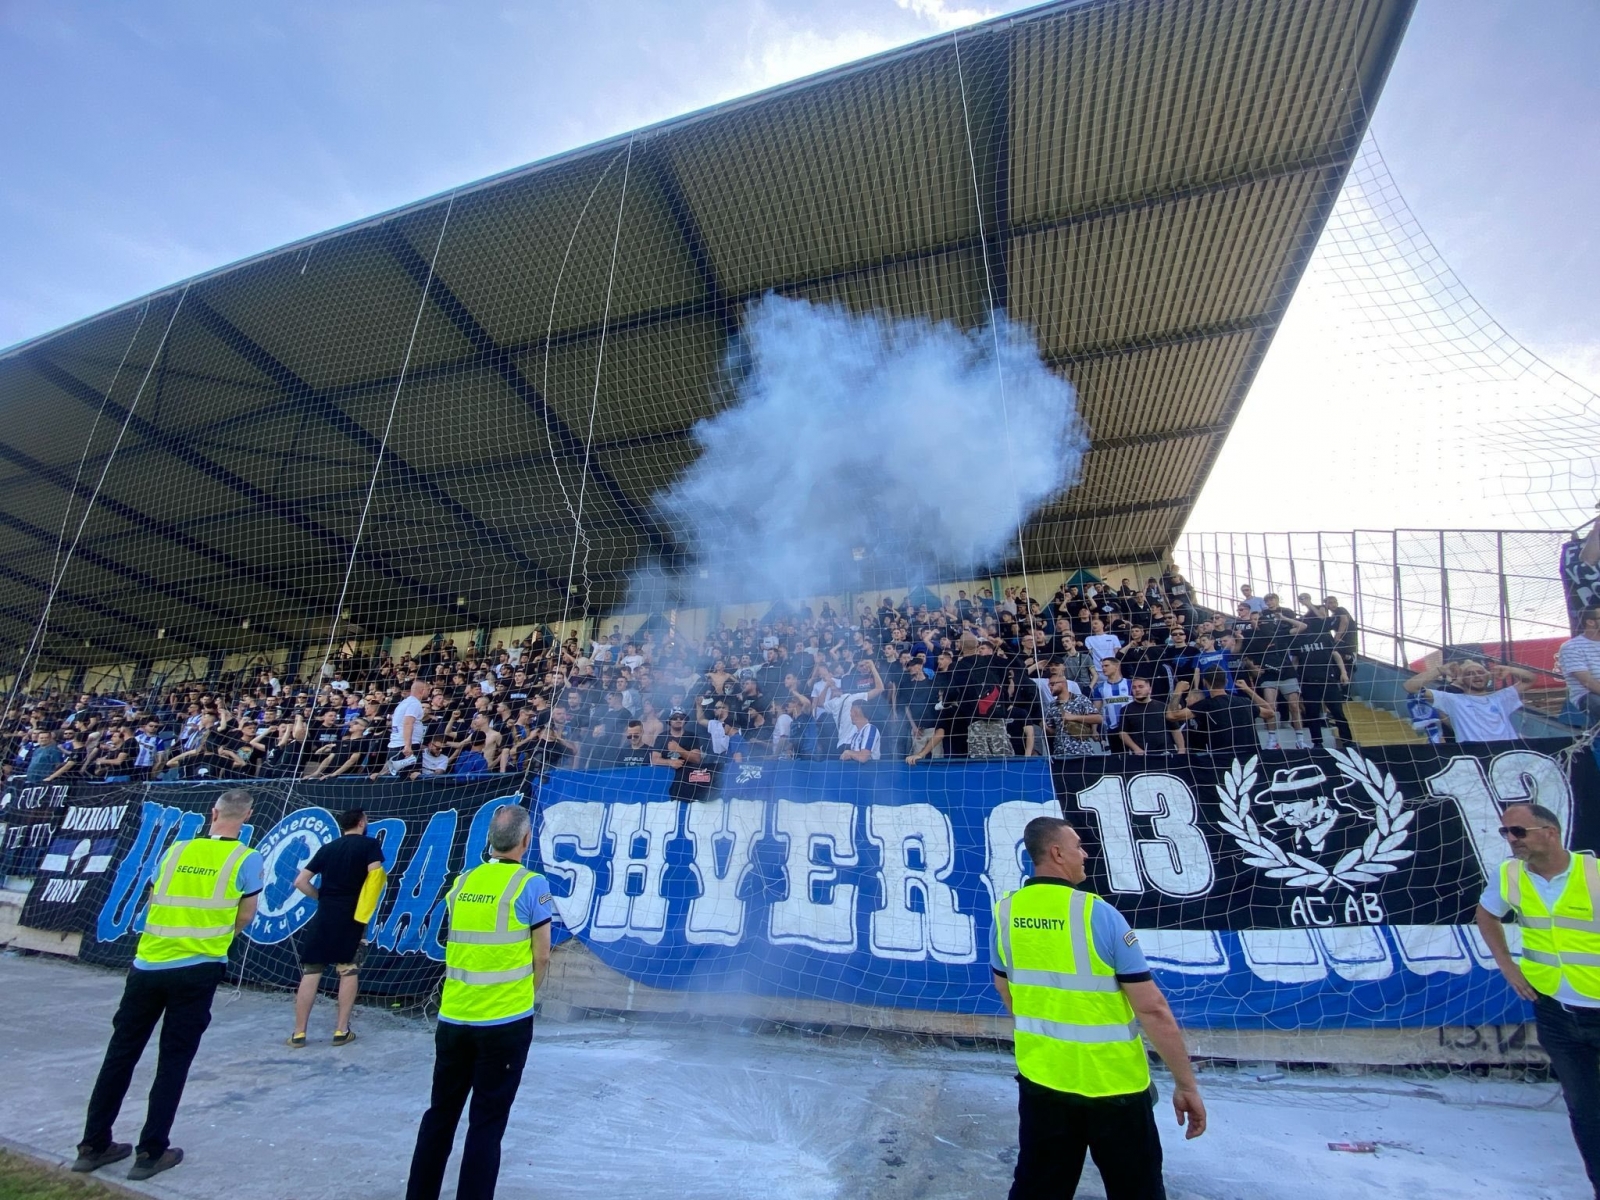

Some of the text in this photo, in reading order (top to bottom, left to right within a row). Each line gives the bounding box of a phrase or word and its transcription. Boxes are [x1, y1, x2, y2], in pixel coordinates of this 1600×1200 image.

[17, 785, 70, 810] FUCK THE
[260, 816, 333, 857] Shvercera
[1076, 773, 1215, 898] 13
[176, 865, 218, 877] SECURITY
[40, 878, 88, 903] FRONT
[457, 892, 497, 904] SECURITY
[1013, 917, 1066, 930] SECURITY
